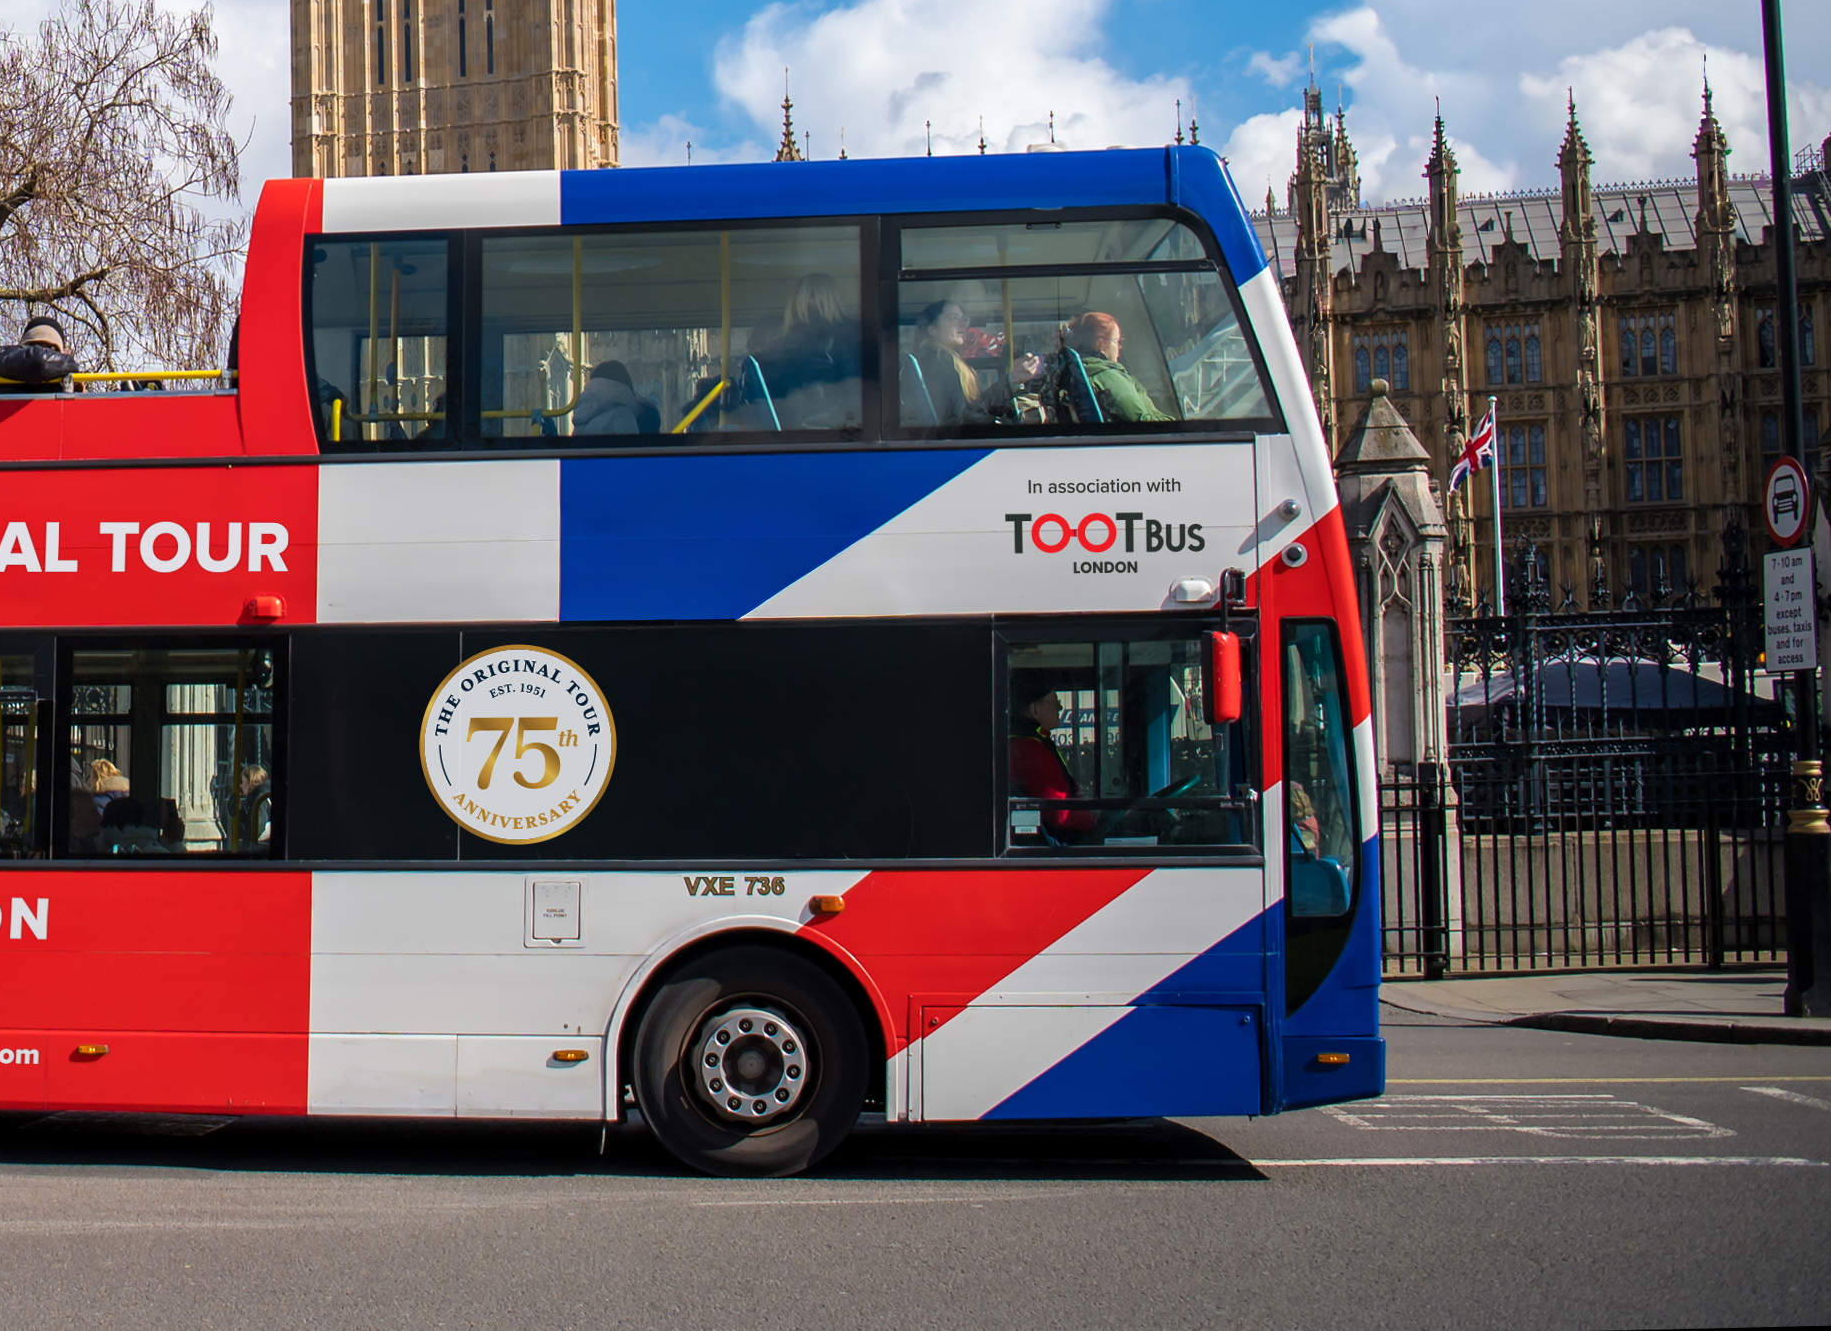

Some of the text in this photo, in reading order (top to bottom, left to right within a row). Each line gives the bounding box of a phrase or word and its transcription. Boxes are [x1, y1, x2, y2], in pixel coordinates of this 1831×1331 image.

[1028, 478, 1182, 494] In association with
[99, 521, 289, 573] TOUR
[1073, 560, 1138, 574] LONDON
[1780, 572, 1795, 586] and
[1776, 606, 1802, 620] except
[1793, 620, 1813, 633] taxis
[1776, 636, 1804, 650] and for
[1777, 653, 1804, 665] access
[435, 659, 601, 737] THE ORIGINAL TOUR
[488, 683, 546, 699] EST. 1951
[452, 789, 582, 830] ANNIVERSARY
[683, 876, 785, 896] VXE 736
